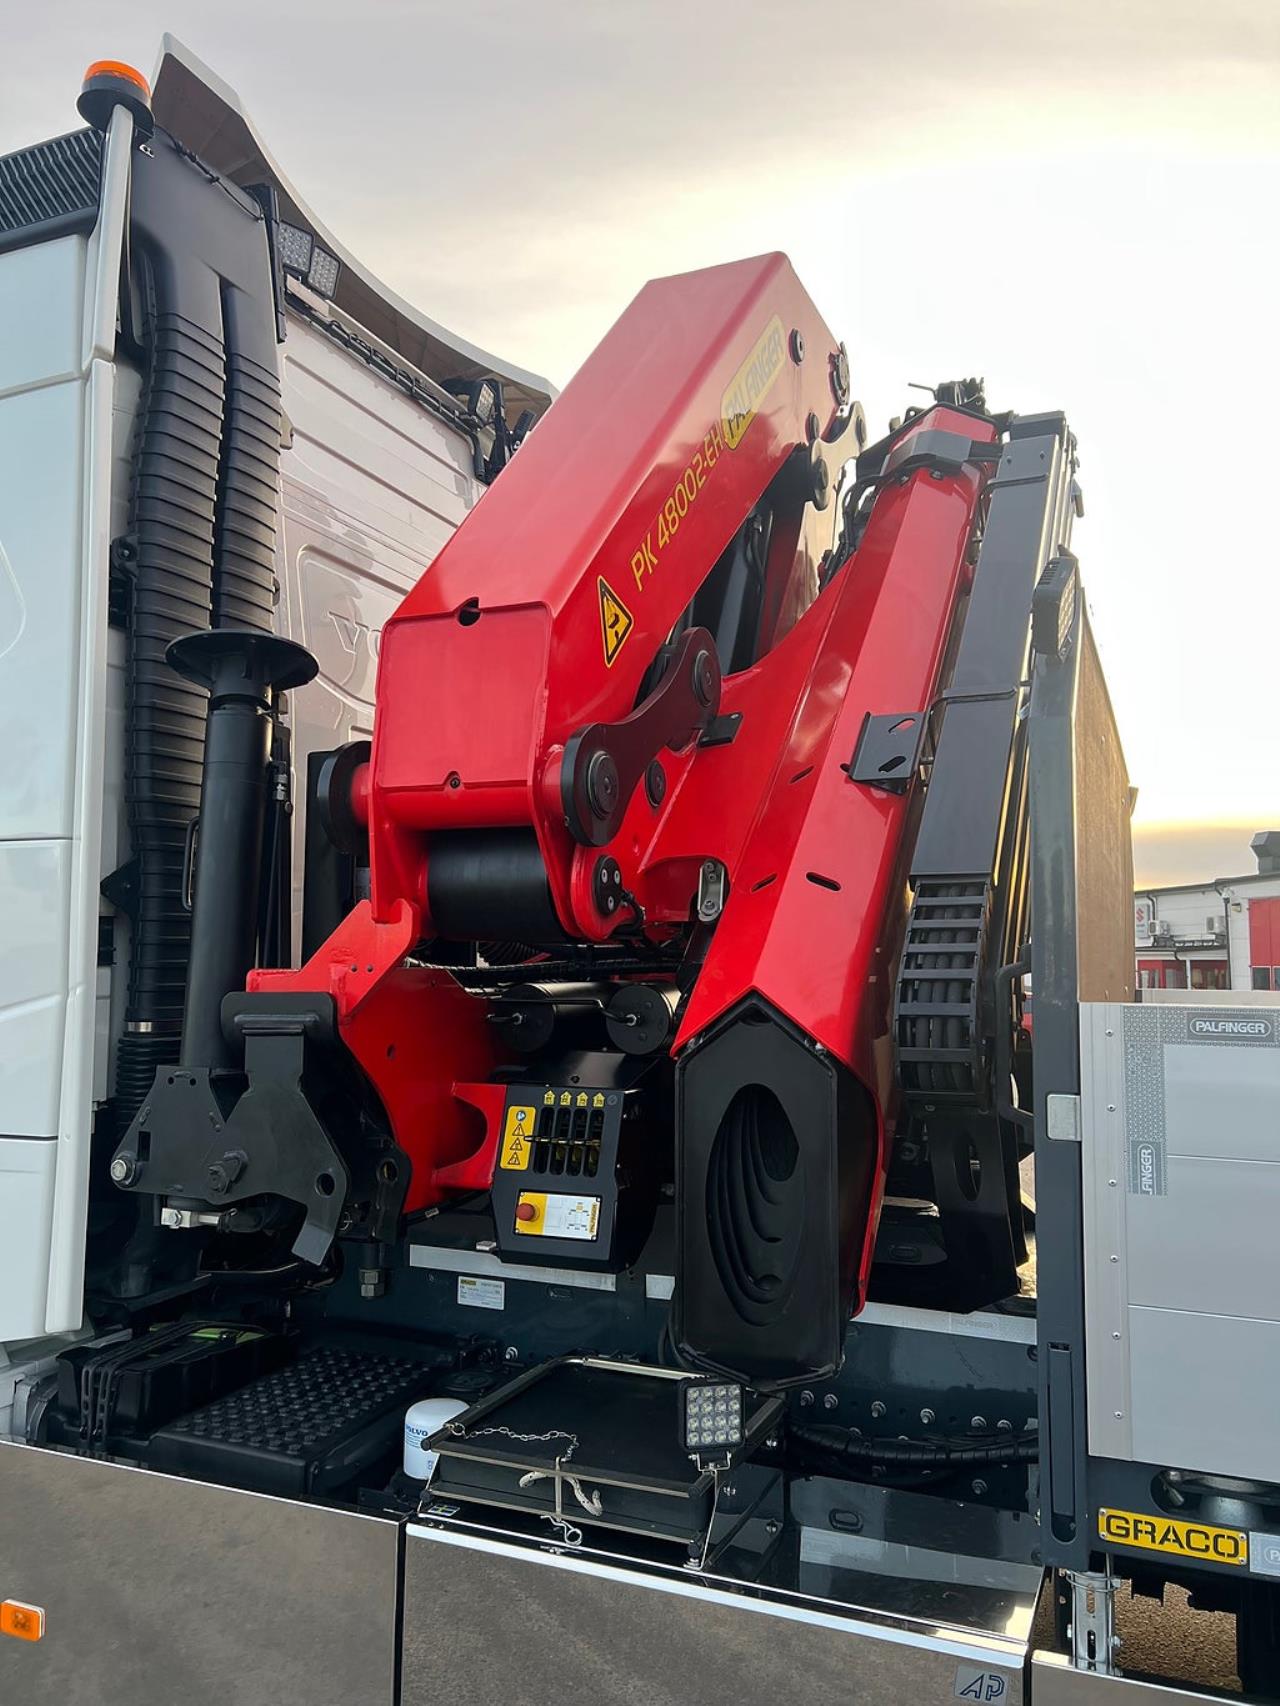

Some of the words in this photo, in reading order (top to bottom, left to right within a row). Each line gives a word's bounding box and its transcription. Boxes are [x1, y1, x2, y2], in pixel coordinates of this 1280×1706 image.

[631, 531, 658, 592] PK
[1194, 1020, 1266, 1034] PALFINGER
[1105, 1514, 1240, 1559] GRACO
[960, 1673, 1005, 1701] AP
